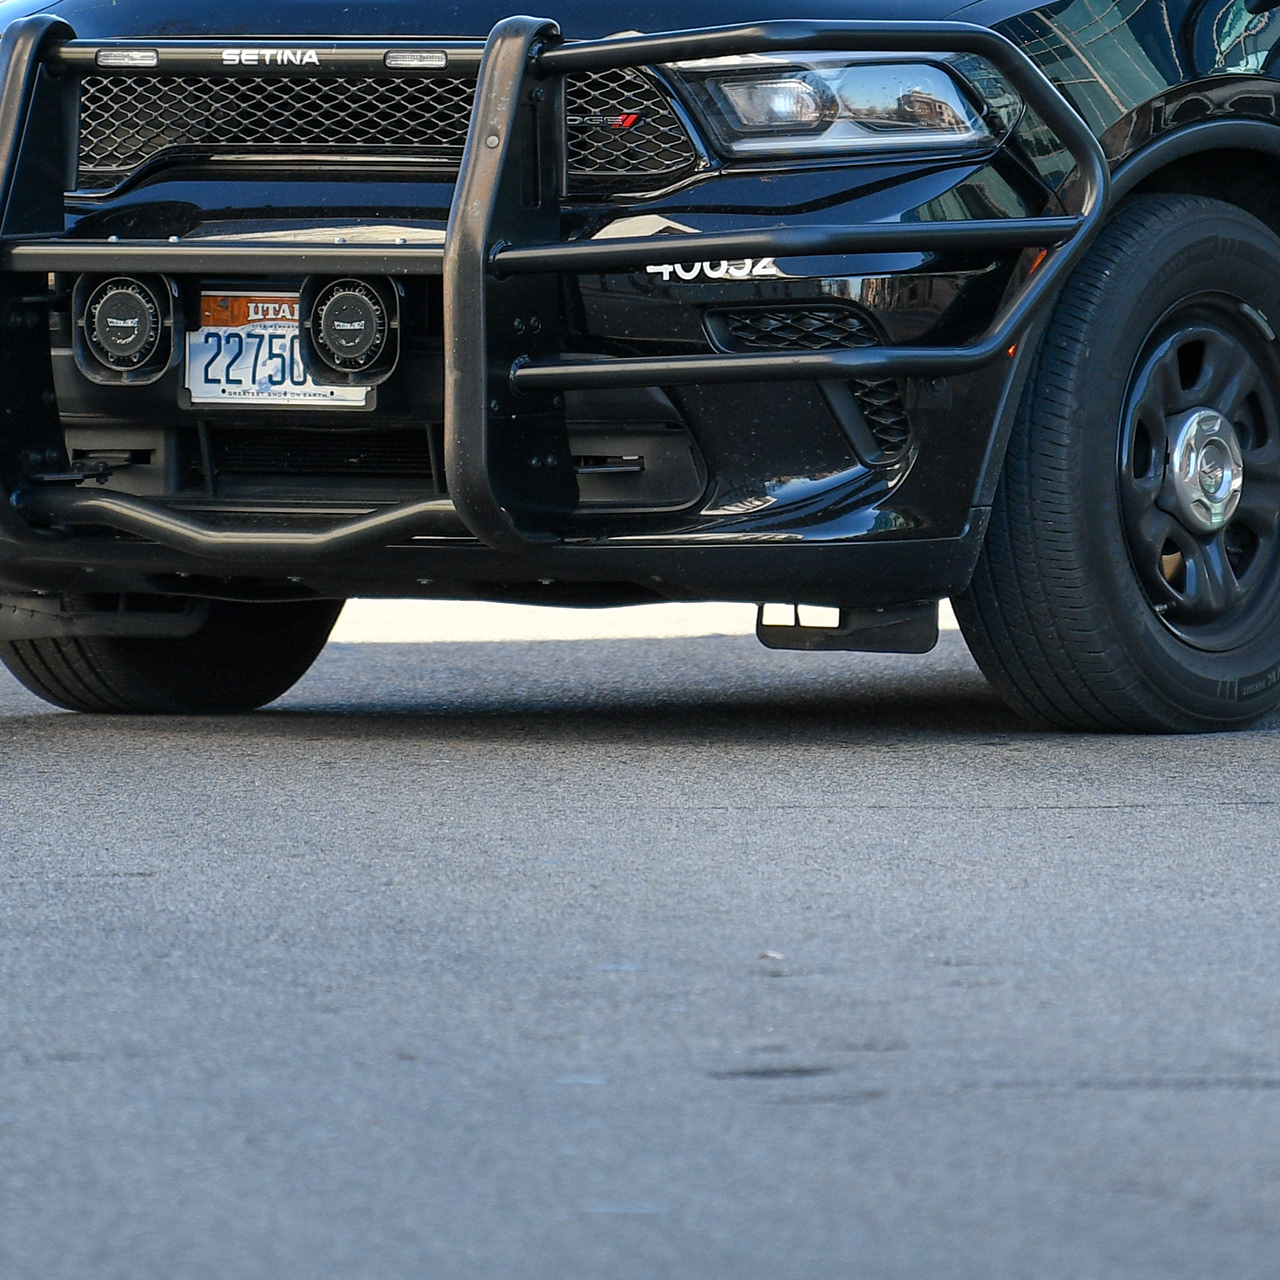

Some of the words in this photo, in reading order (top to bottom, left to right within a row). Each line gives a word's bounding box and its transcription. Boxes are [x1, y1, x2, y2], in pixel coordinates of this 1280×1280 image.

[222, 49, 320, 66] SETINA
[566, 116, 623, 125] DGE
[204, 332, 322, 386] 22750
